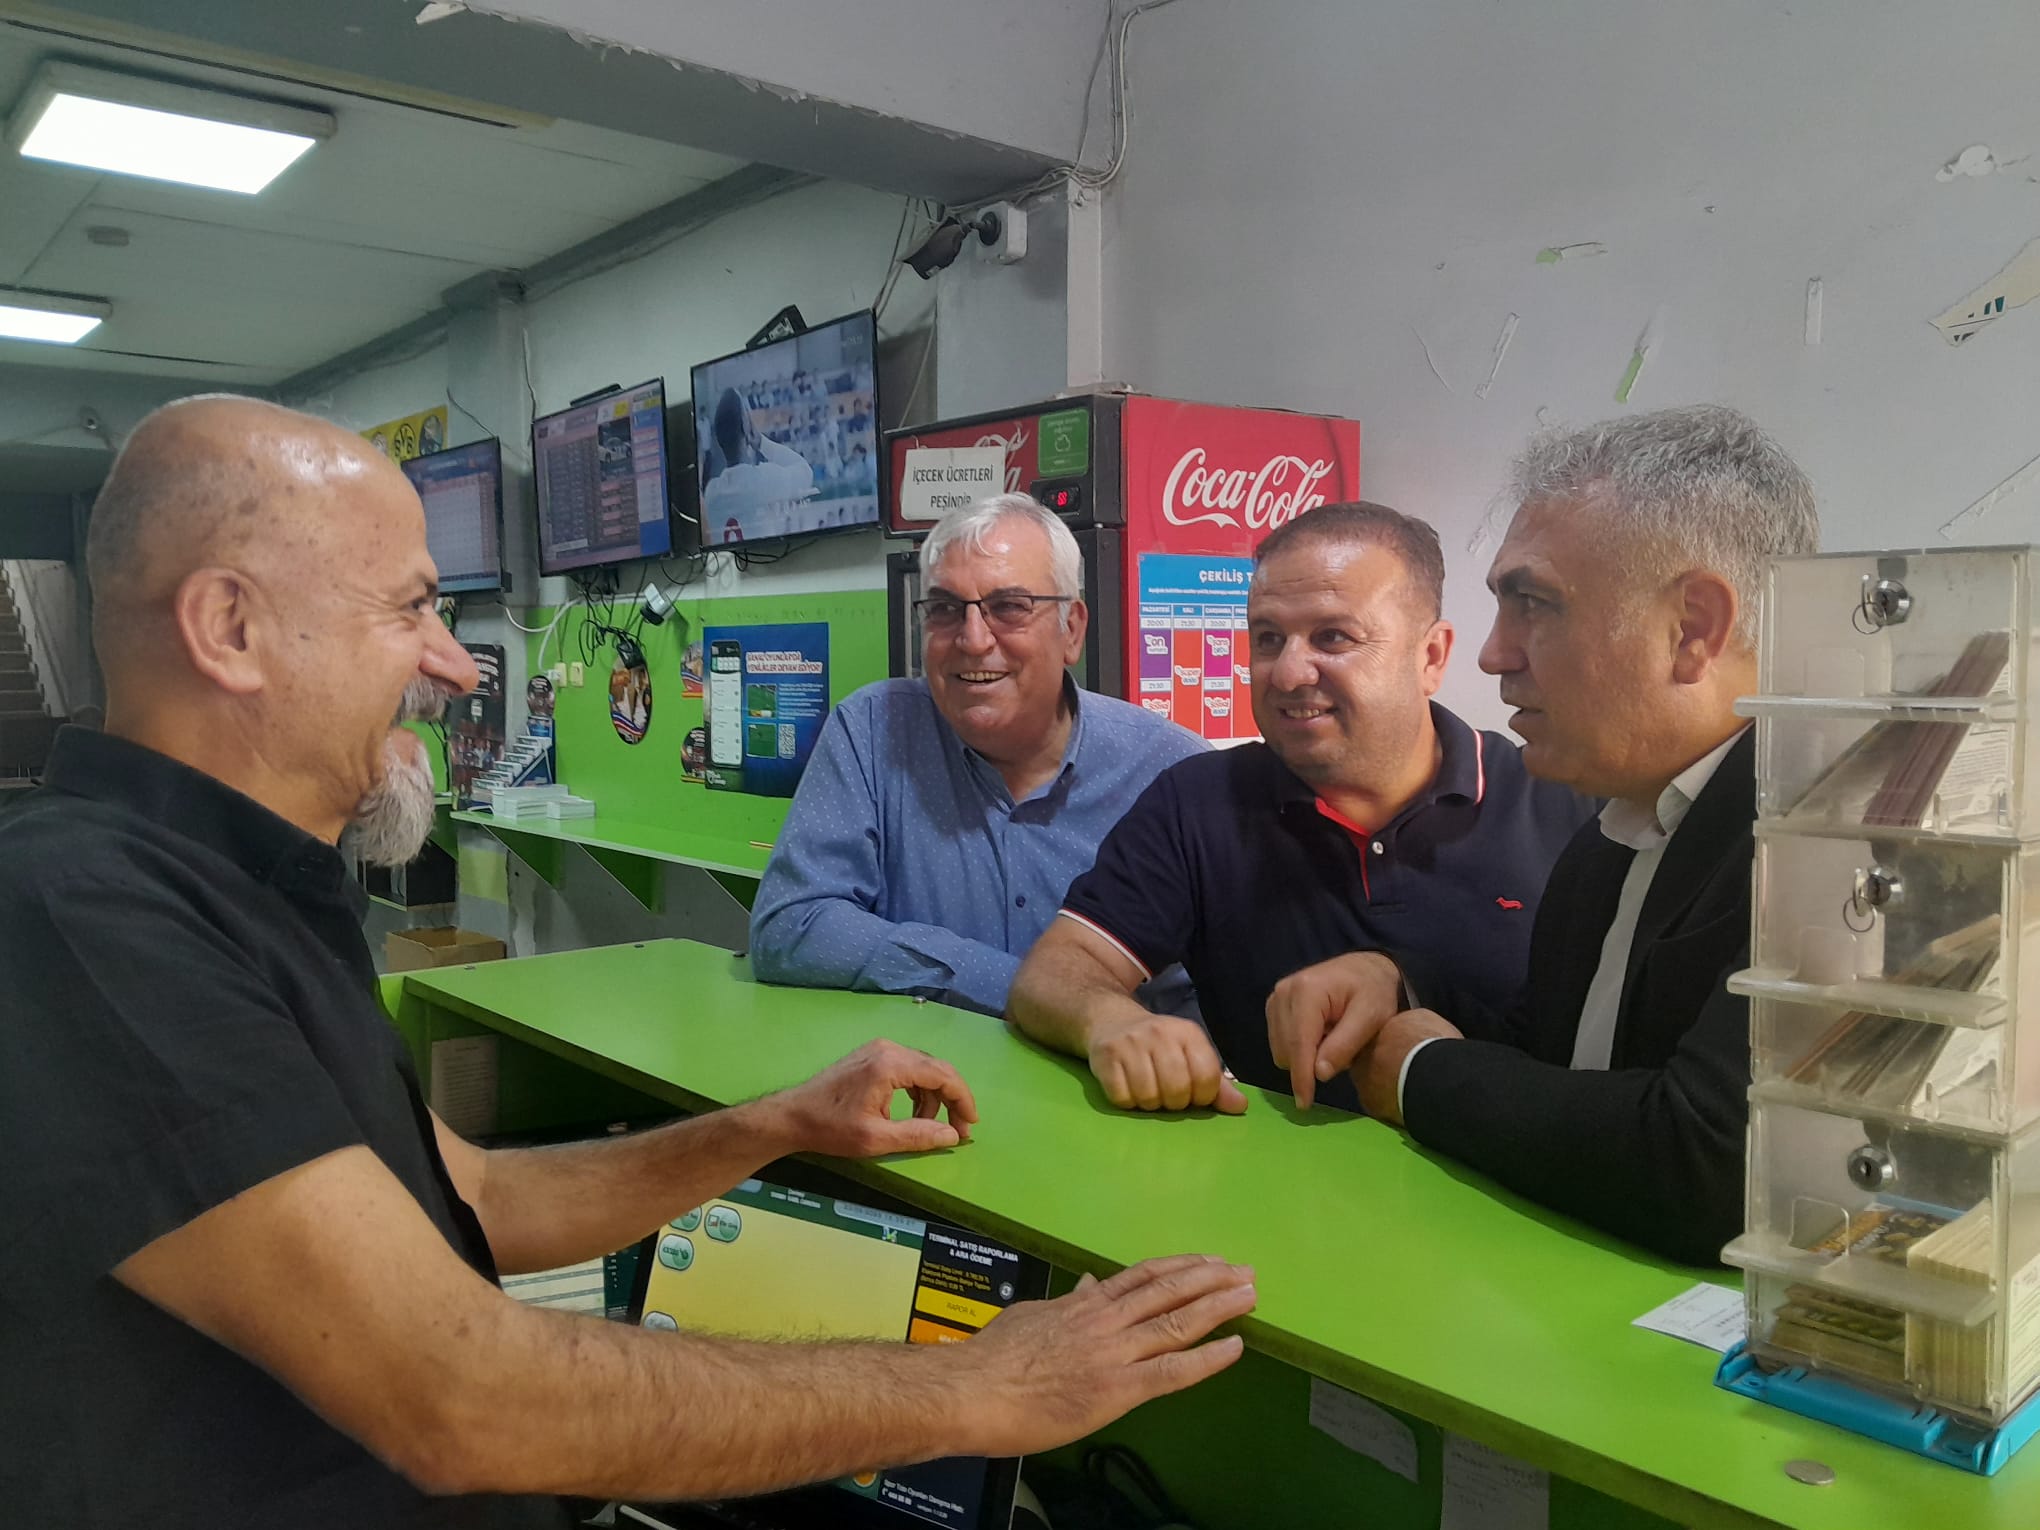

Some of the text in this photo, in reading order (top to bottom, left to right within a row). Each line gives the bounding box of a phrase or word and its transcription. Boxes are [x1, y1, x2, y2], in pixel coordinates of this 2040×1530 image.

[912, 464, 993, 486] İÇECEK ÜCRETLERİ
[1199, 568, 1244, 584] ÇEKİLİŞ
